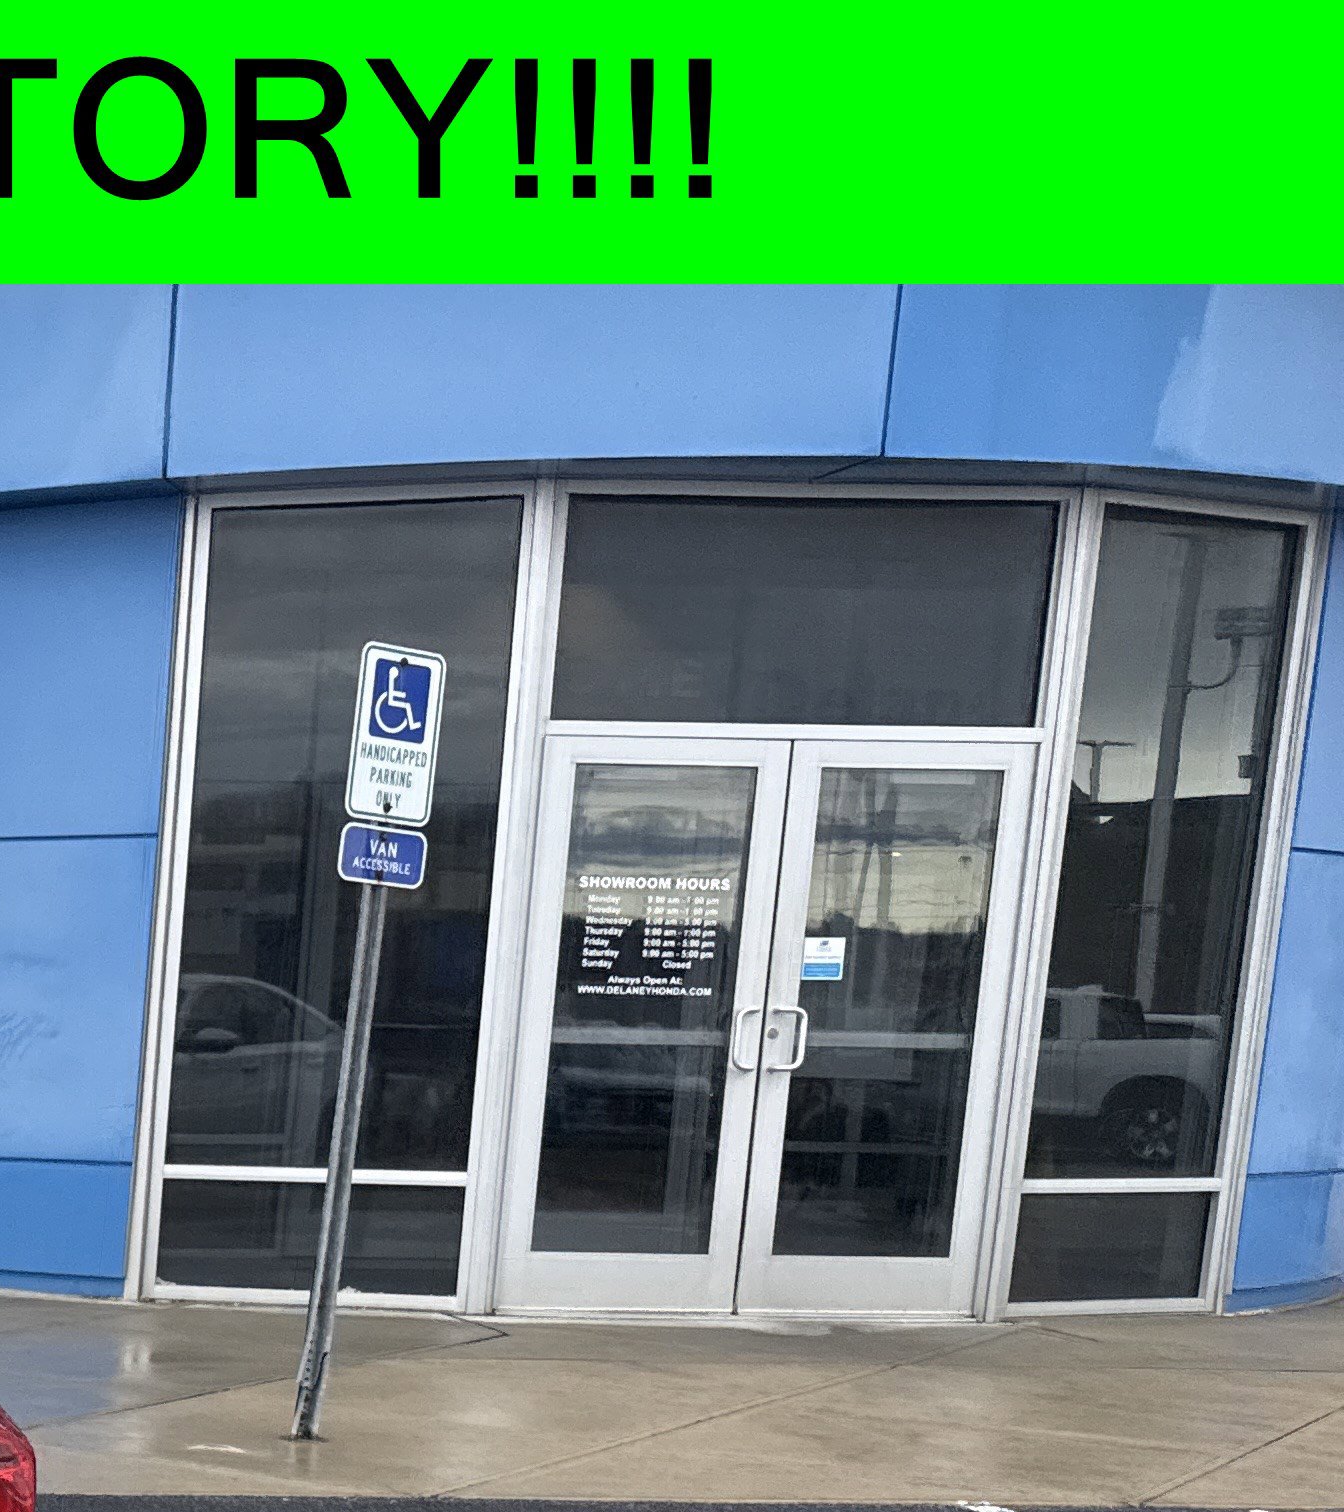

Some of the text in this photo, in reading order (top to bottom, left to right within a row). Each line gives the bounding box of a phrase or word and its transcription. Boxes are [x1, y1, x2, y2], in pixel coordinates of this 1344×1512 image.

[360, 742, 428, 768] HANDICAPPED
[369, 767, 413, 788] PARKING
[369, 839, 398, 858] VAN
[352, 856, 411, 876] ACCESSIBLE
[578, 875, 731, 891] SHOWROOM HOURS
[588, 894, 621, 905] Monday
[586, 916, 634, 927] Wednesday
[584, 926, 624, 937] Thursday
[583, 936, 610, 947] Friday
[701, 941, 715, 949] pm
[582, 947, 620, 959] Saturday
[700, 952, 714, 960] pm
[582, 958, 692, 969] Sunday Closed
[608, 976, 641, 985] Always
[642, 976, 668, 985] Open
[577, 985, 712, 996] WWW.DELANEYHONDA.COM
